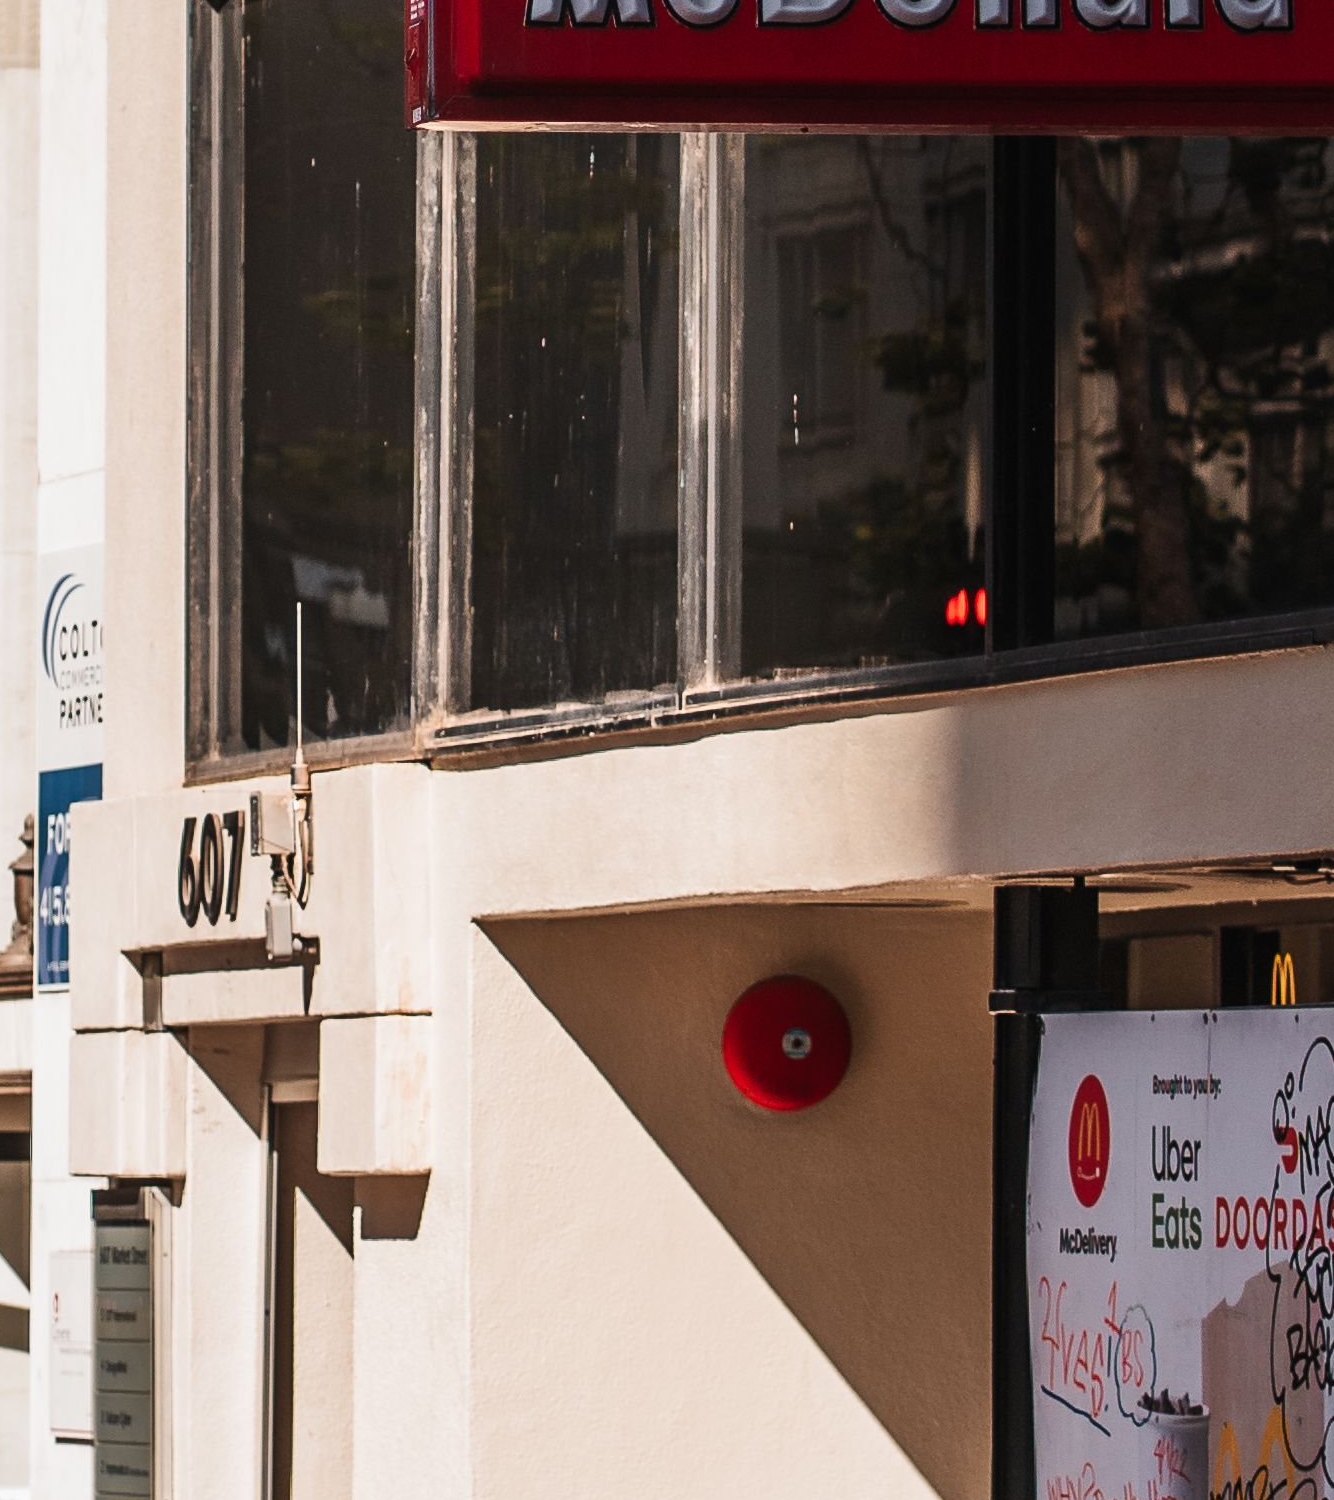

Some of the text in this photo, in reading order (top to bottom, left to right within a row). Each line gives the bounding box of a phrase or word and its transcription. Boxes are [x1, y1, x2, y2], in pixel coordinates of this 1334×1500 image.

[178, 808, 245, 928] 607
[1152, 1126, 1201, 1182] Uber
[1059, 1228, 1117, 1263] McDelivery
[1152, 1193, 1202, 1250] Eats
